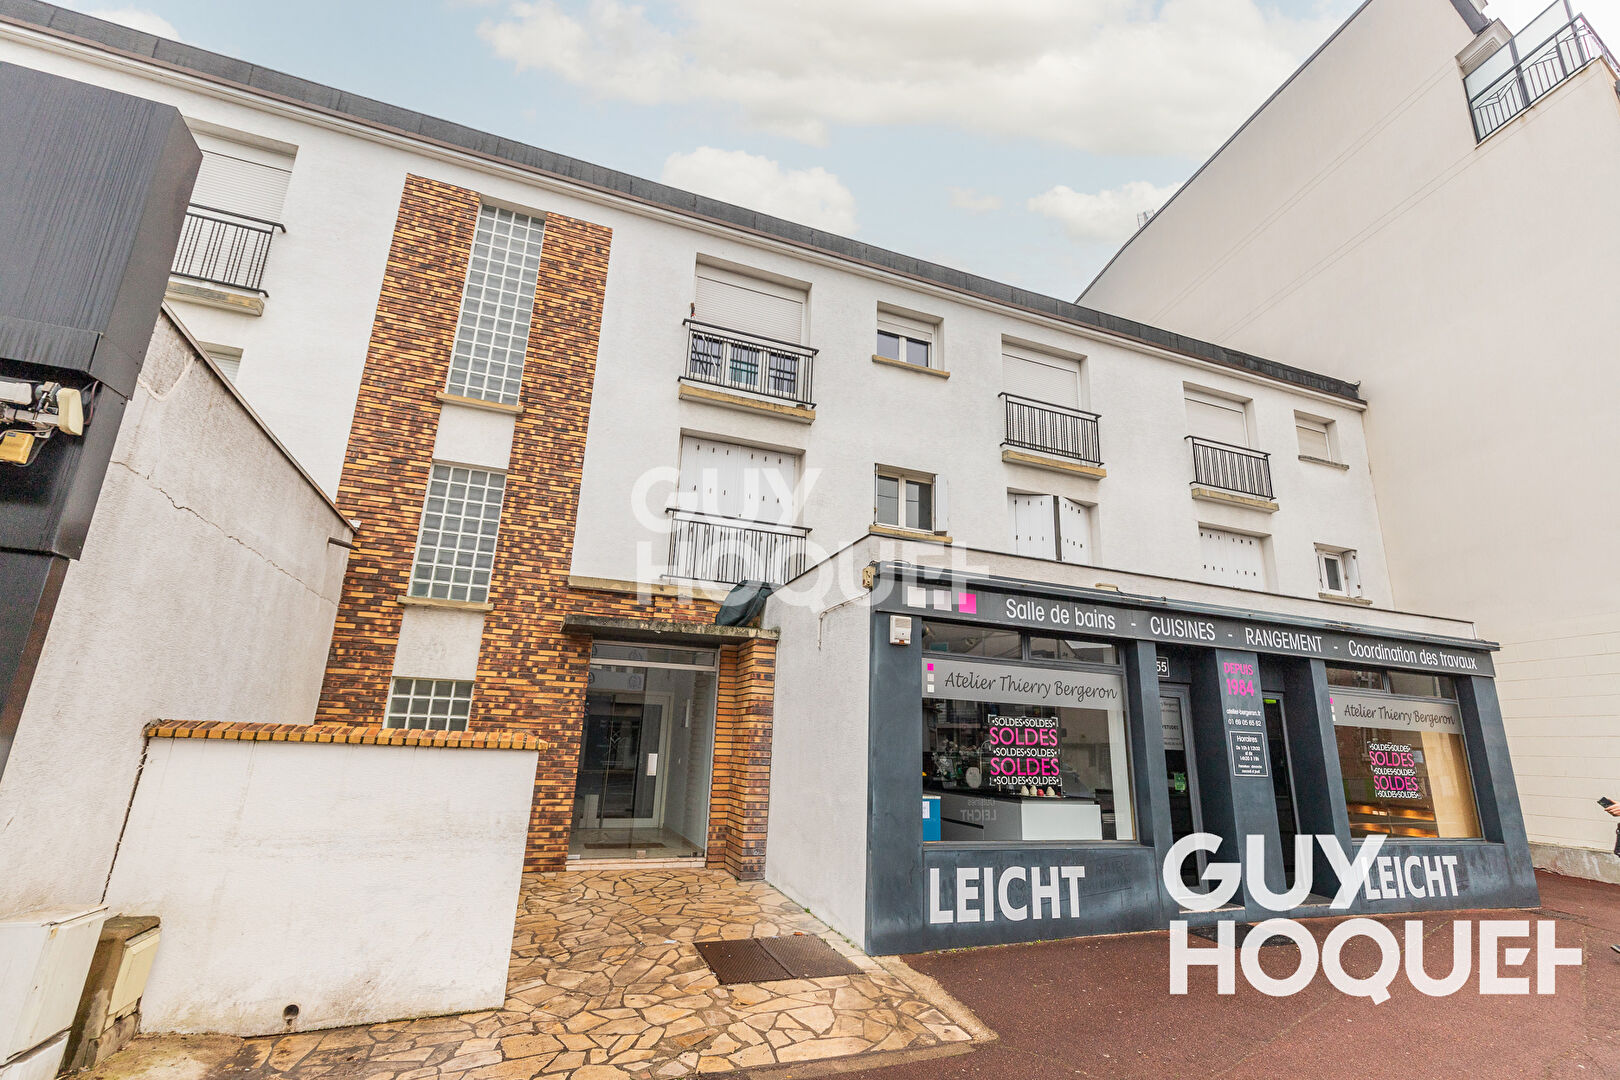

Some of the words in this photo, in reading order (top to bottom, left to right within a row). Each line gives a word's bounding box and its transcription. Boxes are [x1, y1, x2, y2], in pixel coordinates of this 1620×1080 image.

[1006, 598, 1045, 622] Salle
[1050, 605, 1070, 625] de
[1075, 607, 1116, 630] bains
[1150, 616, 1216, 641] CUISINES
[1244, 627, 1322, 653] RANGEMENT
[1348, 640, 1418, 664] Coordination
[1419, 650, 1438, 665] des
[1439, 652, 1478, 669] travaux
[1223, 662, 1254, 676] DEPUIS
[944, 671, 996, 690] Atelier
[999, 674, 1051, 699] Thierry
[1053, 680, 1118, 702] Bergeron
[1226, 678, 1255, 697] 1984
[1344, 703, 1377, 719] Atelier
[1378, 706, 1413, 725] Thierry
[1413, 710, 1456, 728] Bergeron
[989, 726, 1058, 747] SOLDES
[990, 757, 1060, 776] SOLDES
[1369, 751, 1415, 767] SOLDES
[1373, 775, 1419, 791] SOLDES
[1361, 855, 1459, 900] LEICHT
[930, 866, 1086, 924] LEICHT
